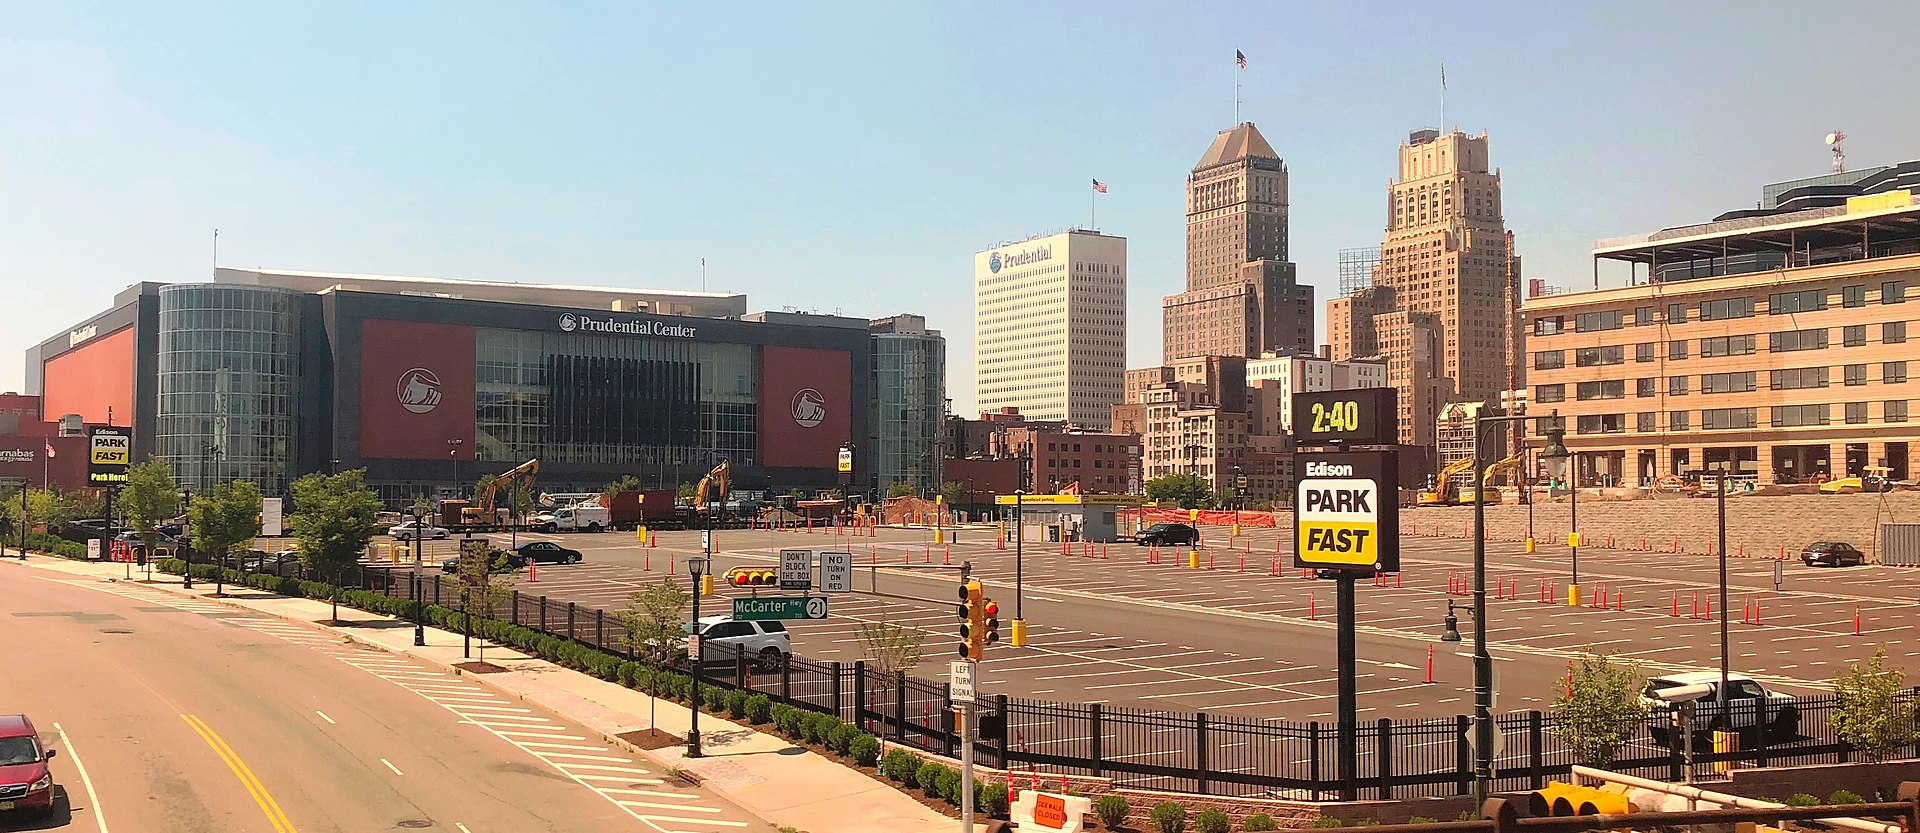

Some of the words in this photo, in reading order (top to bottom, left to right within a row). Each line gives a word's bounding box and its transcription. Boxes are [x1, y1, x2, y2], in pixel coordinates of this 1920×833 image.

[1004, 243, 1052, 269] Prudential
[580, 316, 651, 335] Prudential
[653, 321, 697, 338] Center
[1311, 401, 1358, 433] 2:40
[95, 439, 126, 448] PARK
[96, 452, 125, 461] FAST
[1306, 462, 1353, 477] Edison
[91, 473, 108, 481] Park
[1306, 489, 1371, 513] PARK
[1307, 528, 1369, 553] FAST
[786, 552, 805, 561] DON'T
[828, 556, 843, 564] NO
[785, 562, 806, 571] BLOCK
[827, 565, 845, 573] TURN
[782, 572, 794, 580] THE
[797, 572, 810, 580] BOX
[828, 582, 842, 590] RED
[735, 600, 786, 613] McCarter
[810, 601, 823, 615] 21
[955, 666, 970, 674] LEFT
[955, 677, 971, 685] TURN
[952, 688, 974, 698] SIGNAL
[1038, 800, 1062, 811] SIDEWALK
[1037, 810, 1061, 821] CLOSED
